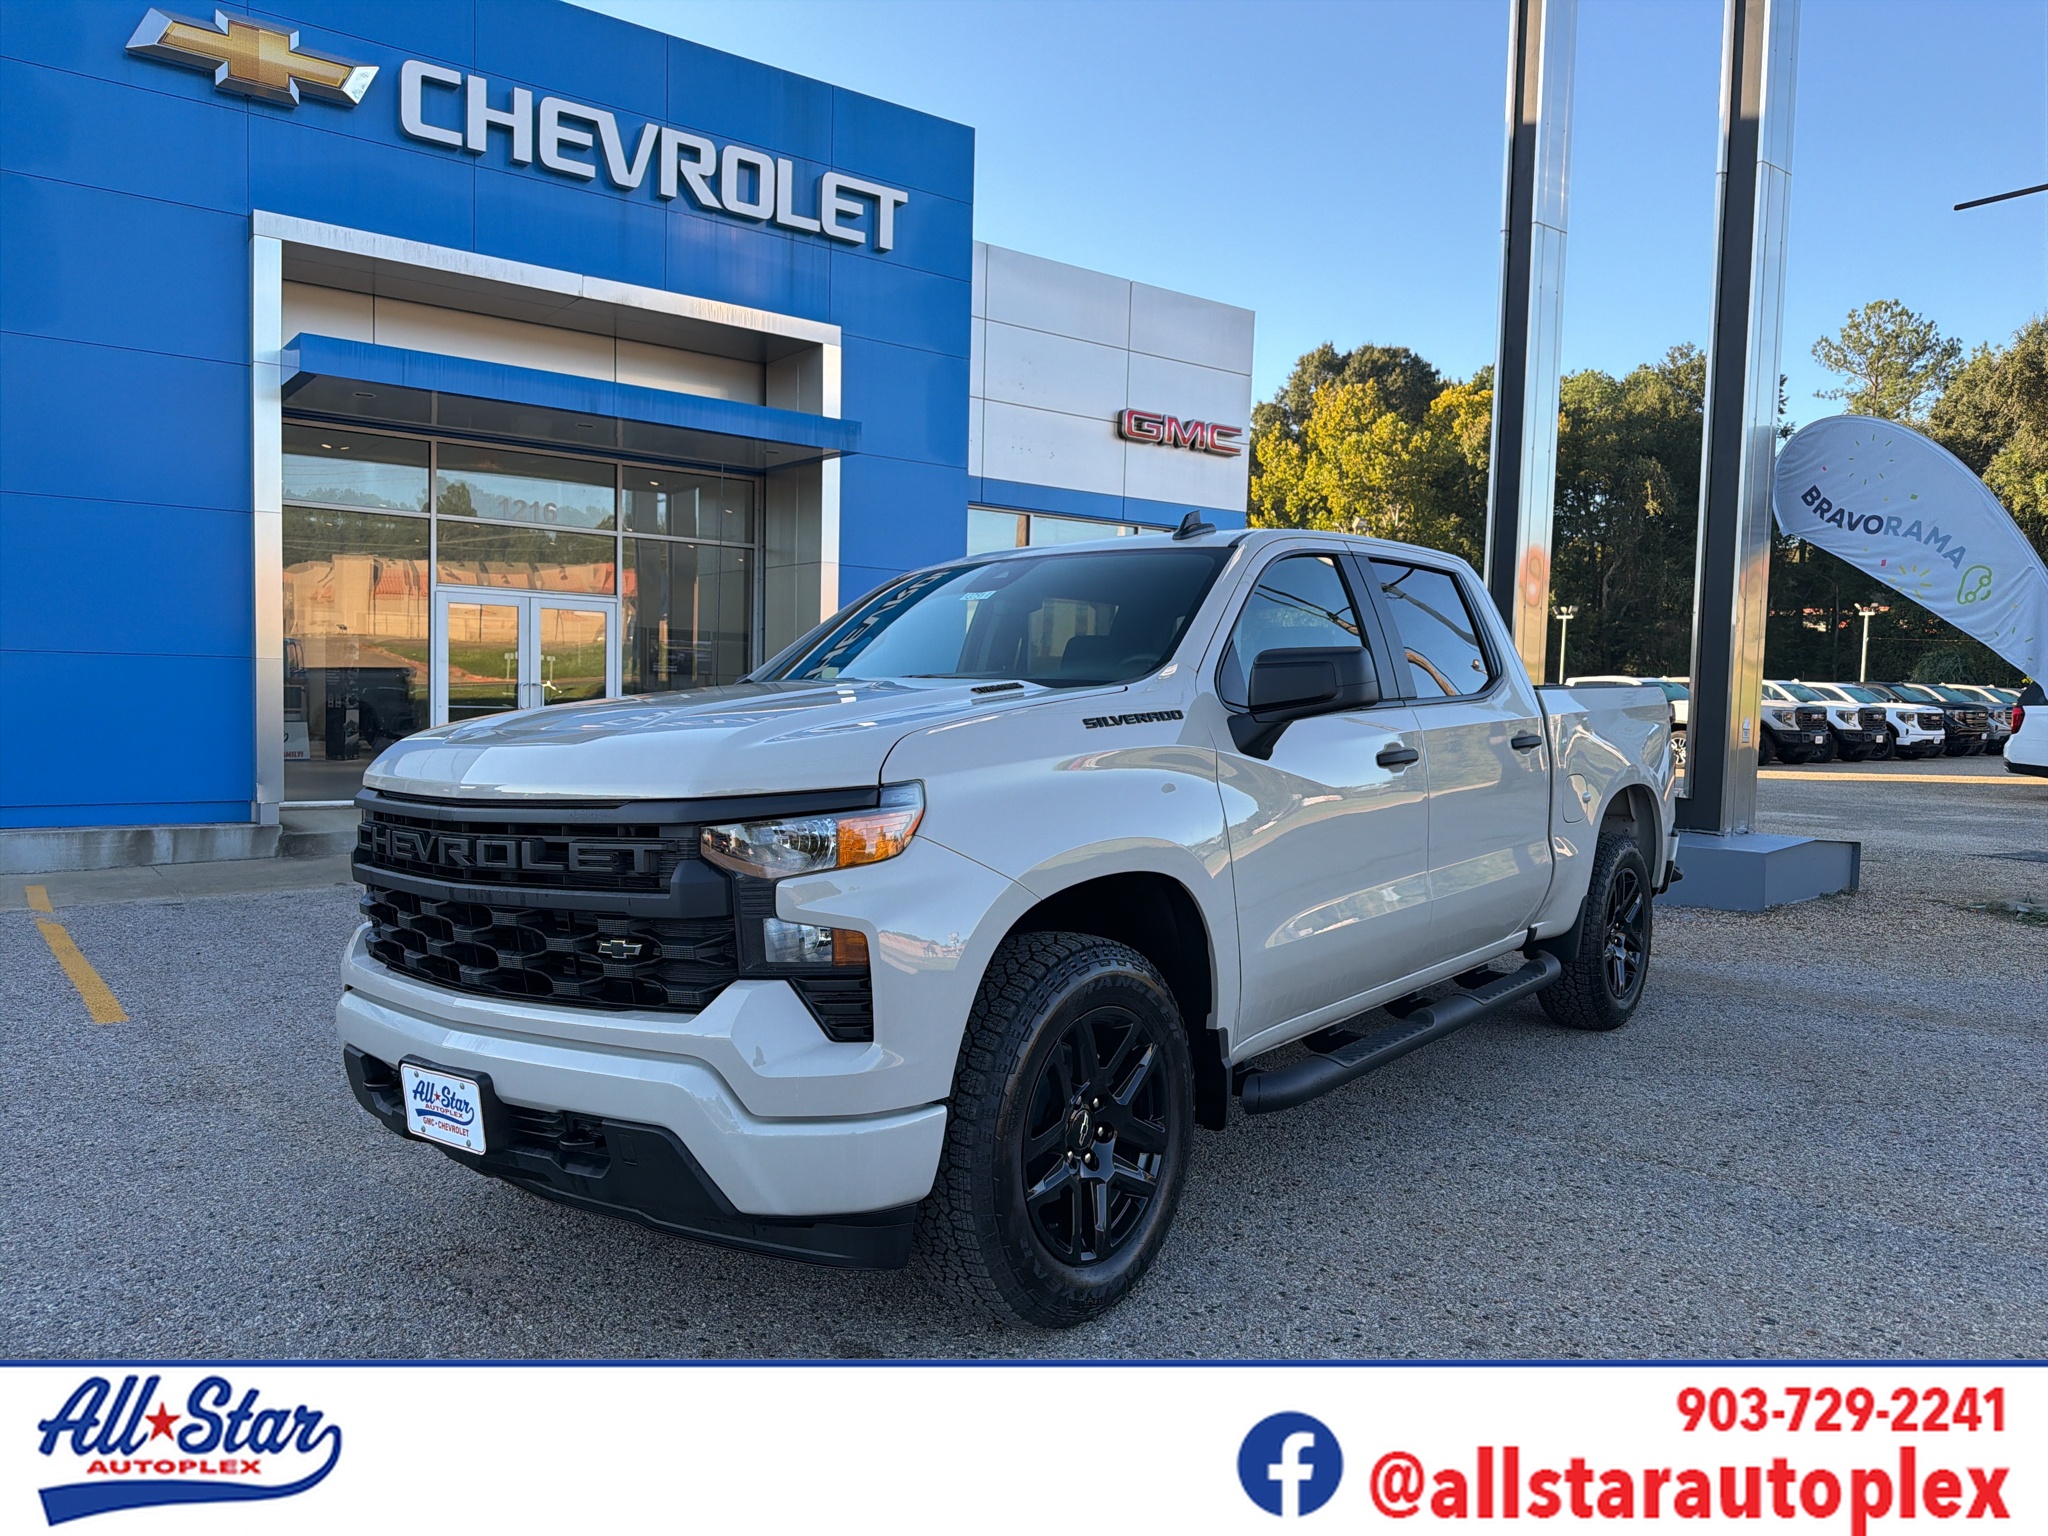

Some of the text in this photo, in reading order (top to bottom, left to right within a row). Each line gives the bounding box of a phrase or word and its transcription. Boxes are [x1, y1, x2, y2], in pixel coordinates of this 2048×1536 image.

[399, 59, 909, 253] CHEVROLET
[1119, 408, 1242, 455] GMC
[499, 498, 558, 521] 1216
[1801, 484, 1967, 570] BRAVORAMA
[1082, 709, 1184, 729] SILVERADO
[358, 823, 670, 874] CHEVROLET
[412, 1080, 473, 1114] All Star
[425, 1103, 463, 1119] AUTOPLEX
[437, 1120, 469, 1136] CHEVROLET
